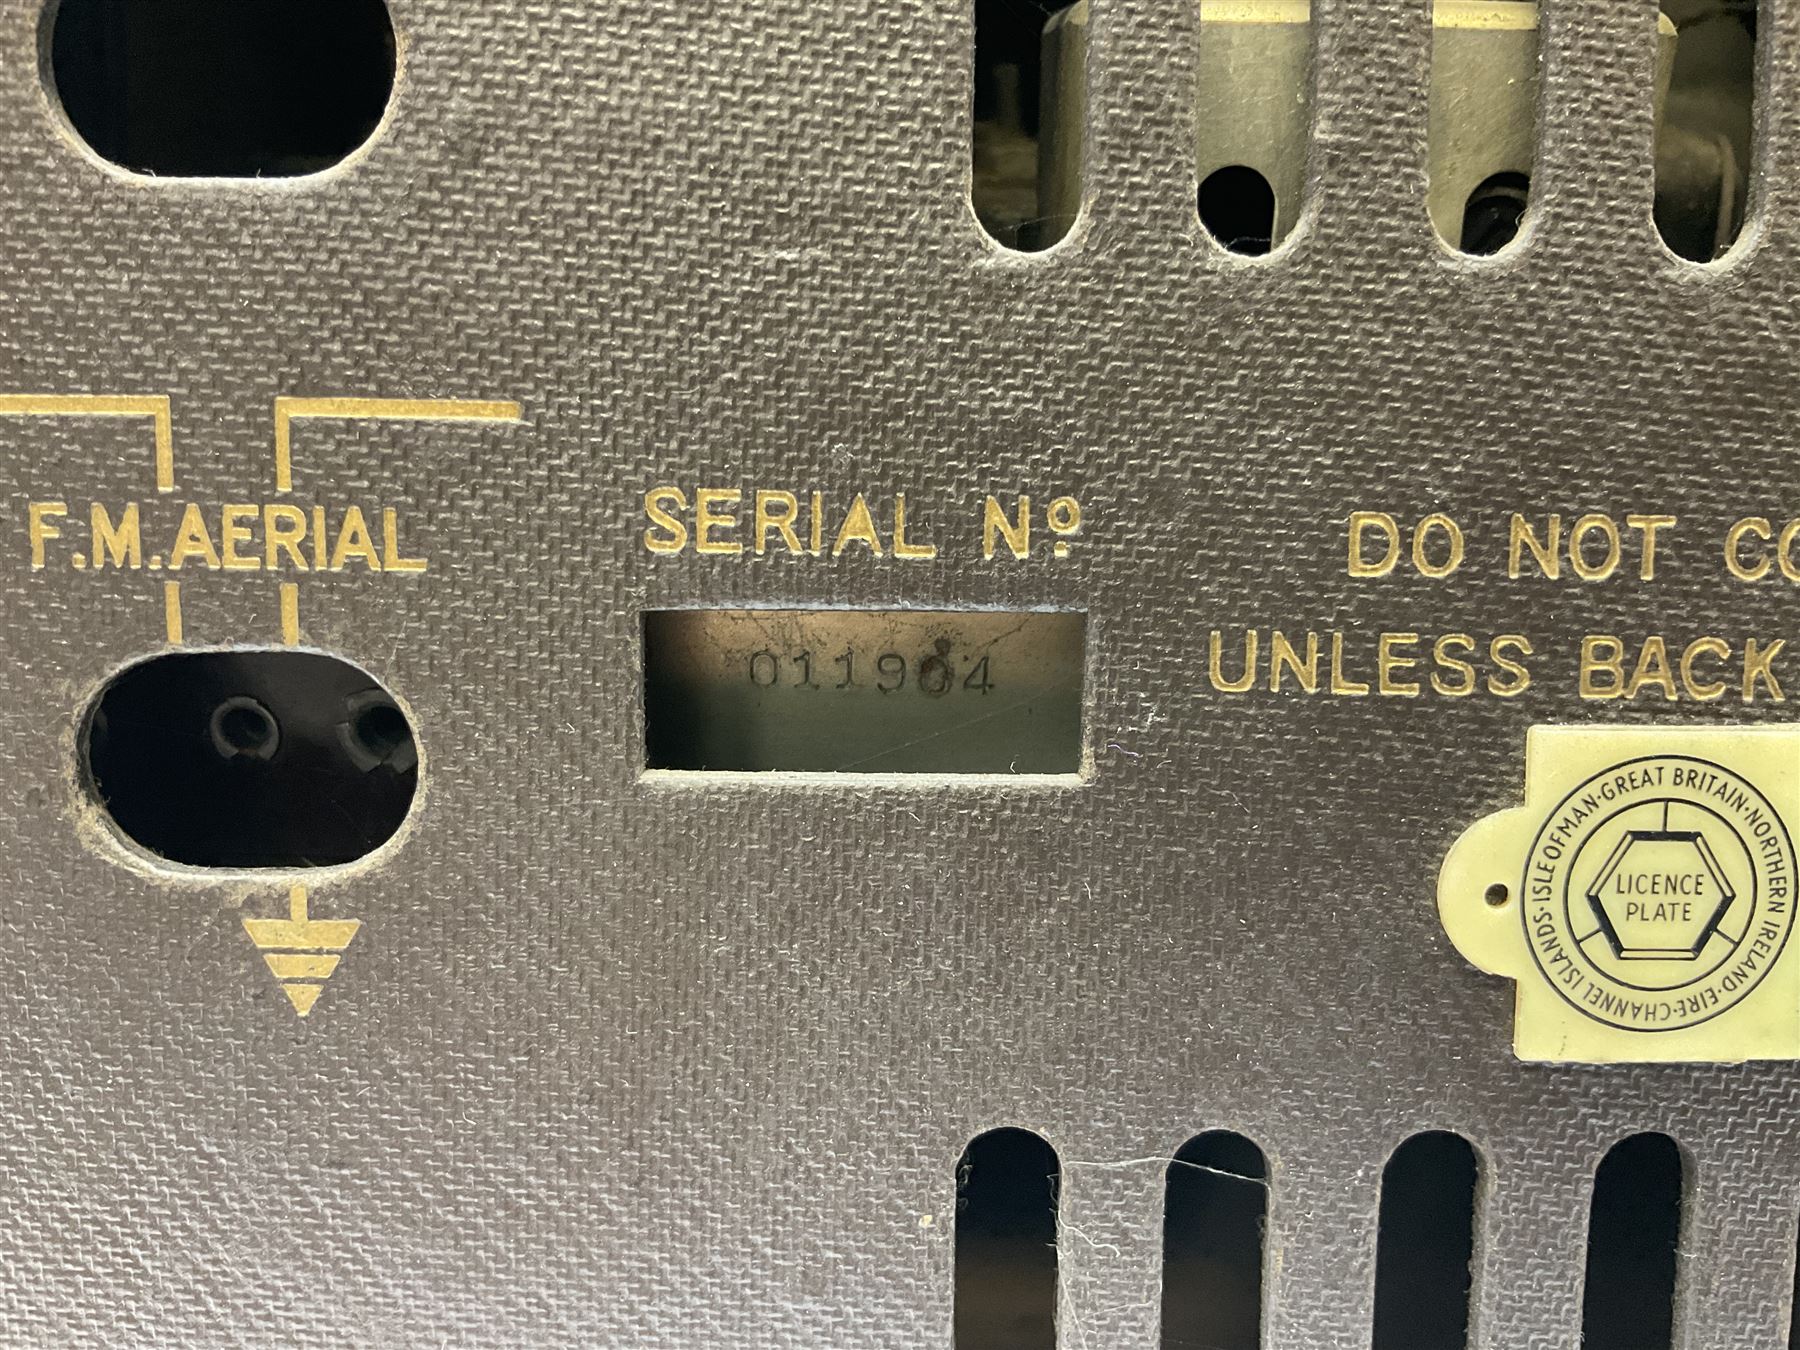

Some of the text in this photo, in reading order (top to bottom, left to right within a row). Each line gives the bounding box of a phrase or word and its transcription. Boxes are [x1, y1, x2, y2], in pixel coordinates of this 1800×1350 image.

[643, 486, 937, 558] SERIAL
[1347, 511, 1464, 579] DO
[1508, 513, 1677, 581] NOT
[1208, 630, 1786, 703] UNLESS BACK
[1616, 873, 1704, 896] LICENCE
[1625, 902, 1692, 922] PLATE
